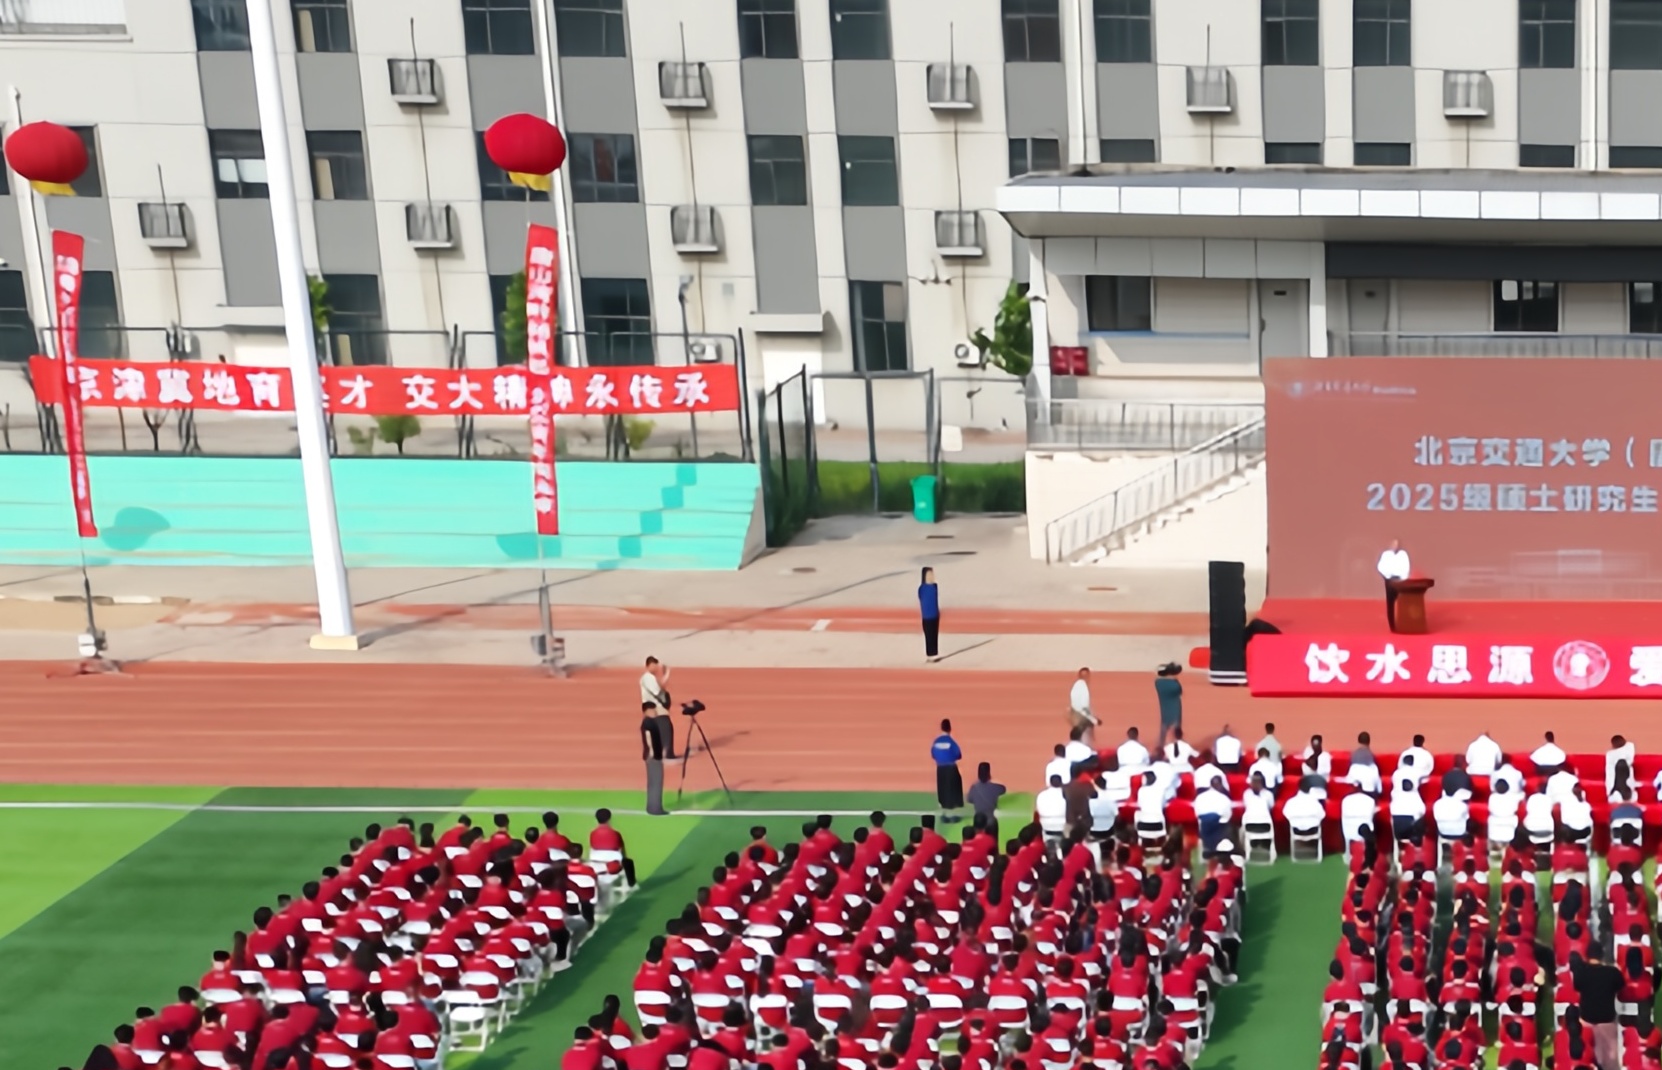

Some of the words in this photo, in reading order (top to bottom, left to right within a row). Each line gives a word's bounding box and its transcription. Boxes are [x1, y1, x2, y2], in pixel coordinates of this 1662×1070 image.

[78, 366, 373, 409] 京津冀地育才
[1304, 643, 1534, 686] 饮水思源
